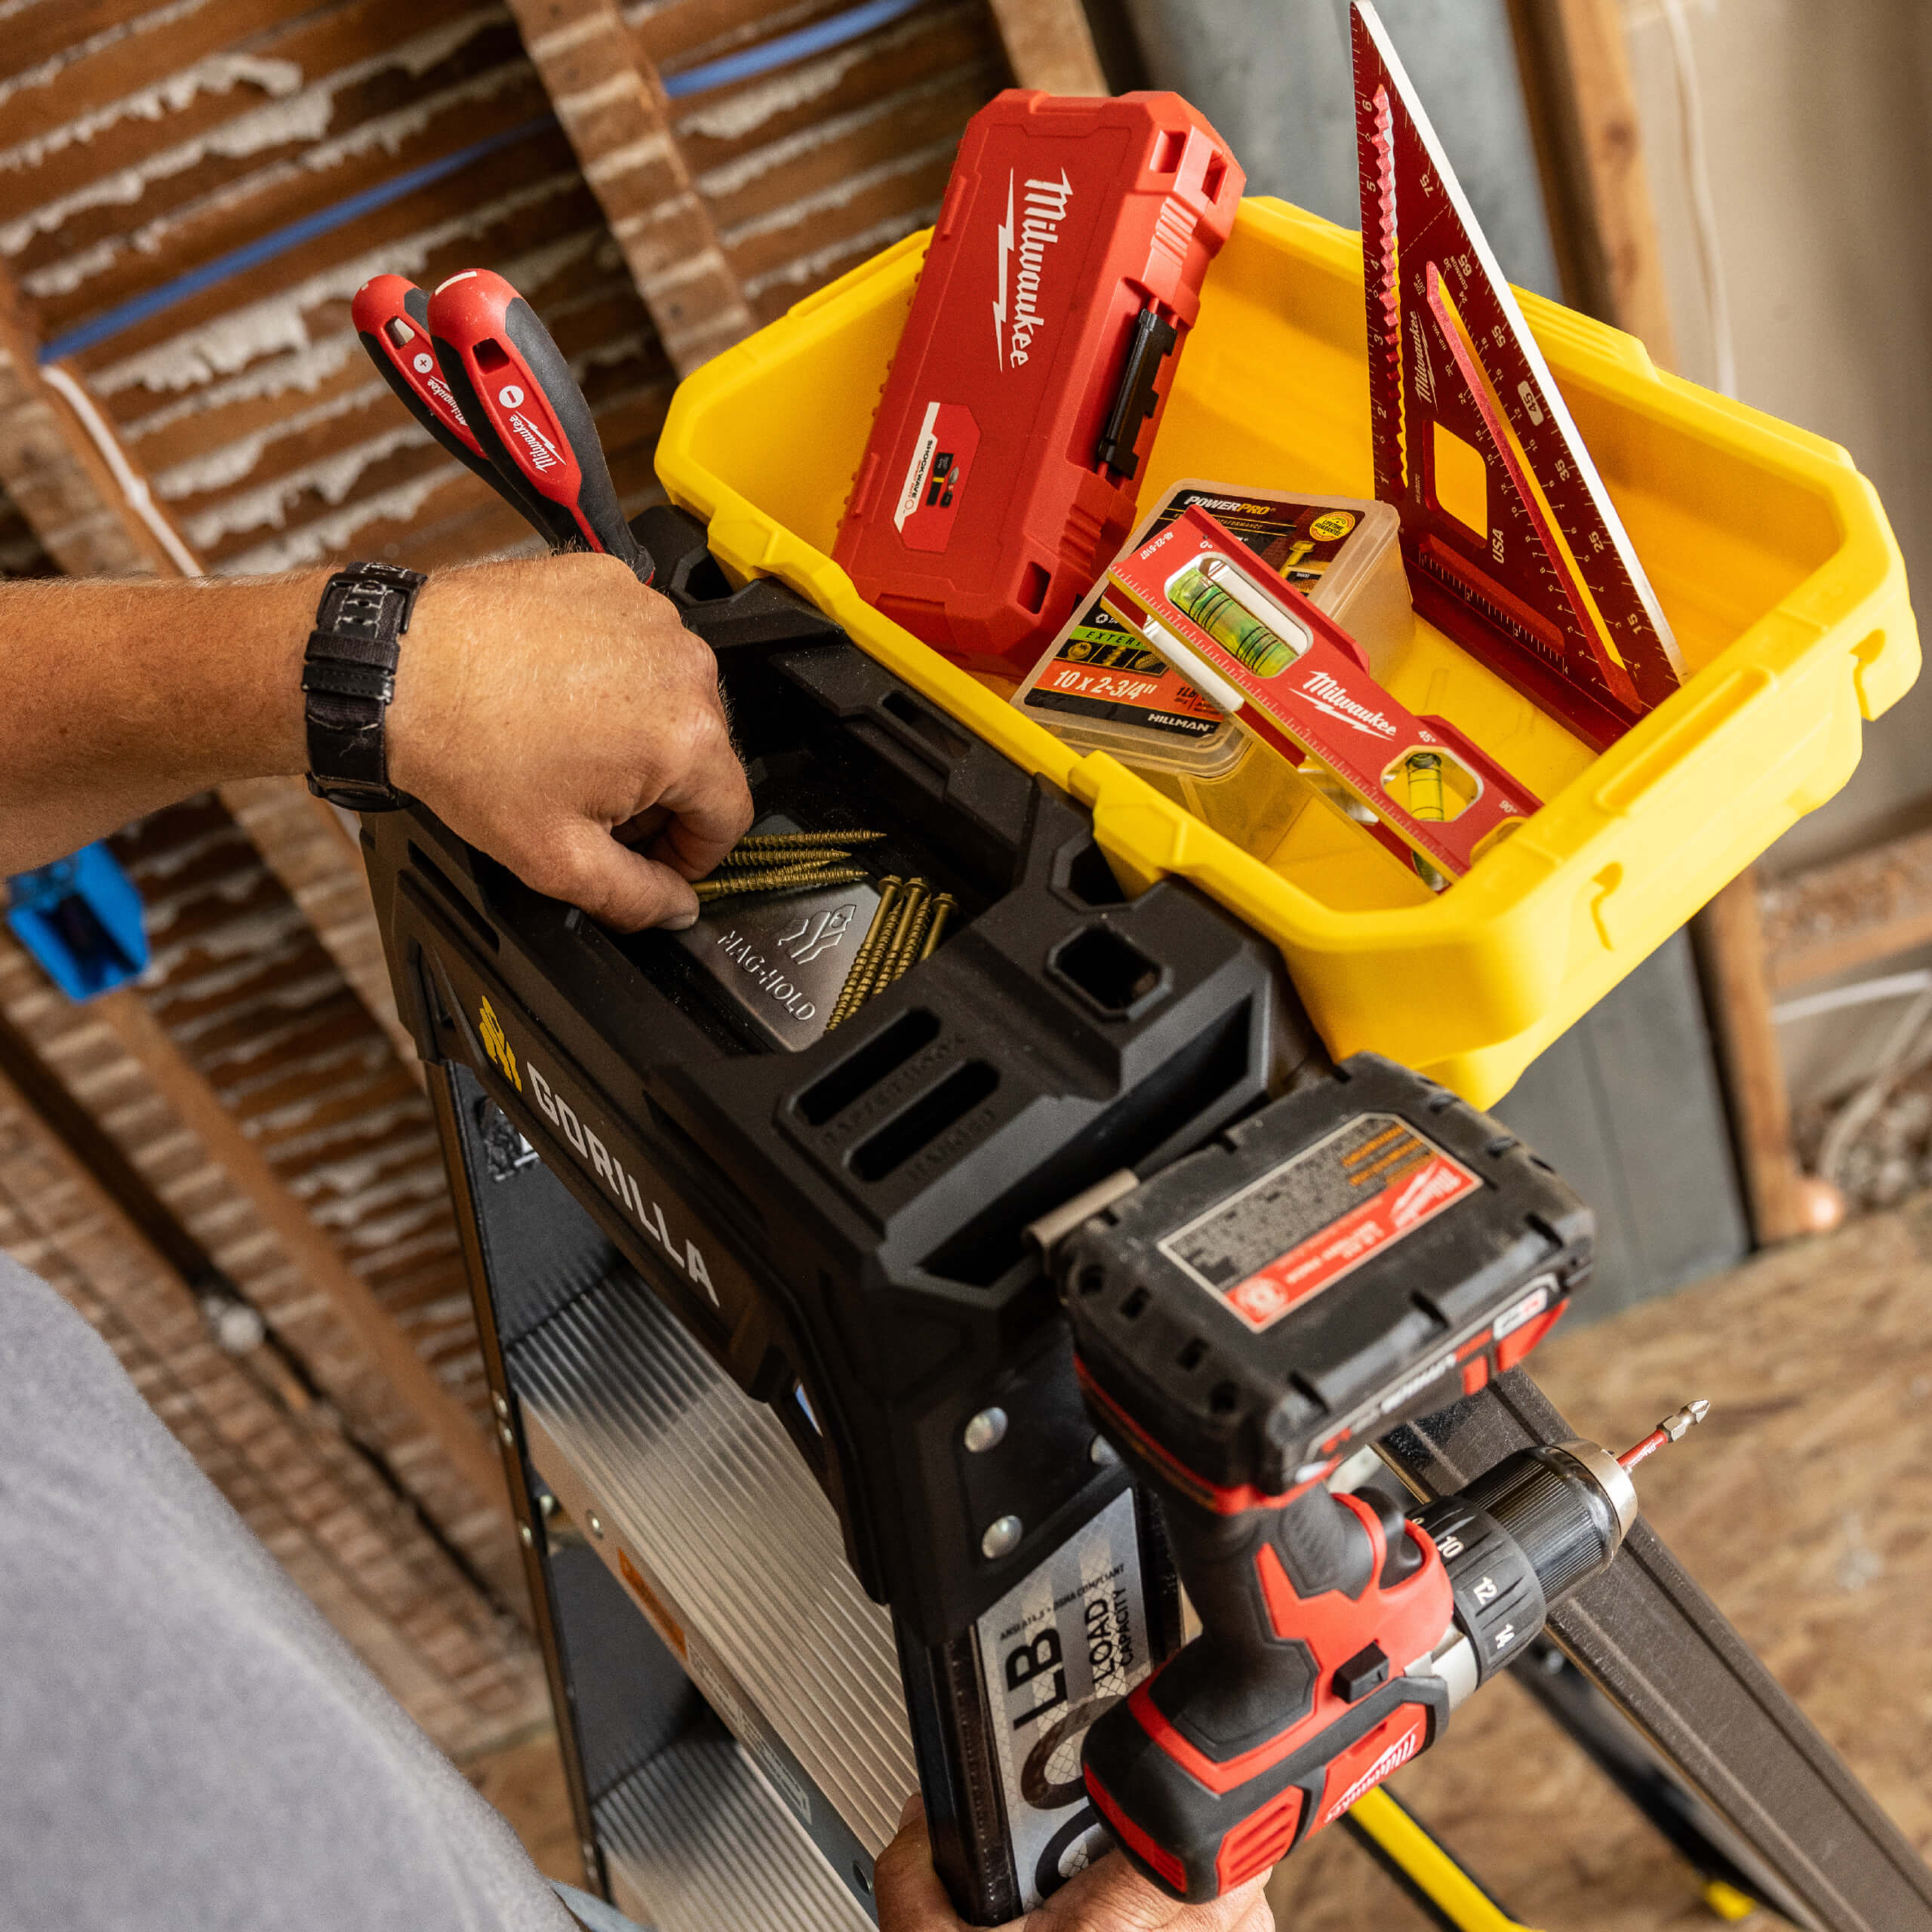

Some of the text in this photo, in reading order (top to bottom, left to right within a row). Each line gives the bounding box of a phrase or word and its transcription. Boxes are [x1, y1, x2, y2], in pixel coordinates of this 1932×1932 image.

[1362, 100, 1373, 112] 6
[1366, 180, 1377, 192] 5
[1420, 174, 1434, 198] 75
[1010, 166, 1074, 368] Milwaukee
[1370, 259, 1380, 270] 4
[1443, 257, 1452, 271] 30
[1450, 255, 1468, 291] COMMON
[1457, 254, 1472, 276] 65
[1459, 291, 1468, 303] 24
[1374, 334, 1383, 346] 3
[1481, 337, 1490, 349] 18
[1491, 325, 1506, 348] 55
[1409, 310, 1432, 404] Milwaukee
[1444, 365, 1454, 377] 30
[1496, 368, 1504, 380] 15
[1458, 392, 1467, 405] 24
[1523, 392, 1537, 412] 45
[1377, 406, 1386, 418] 2
[1514, 407, 1522, 420] 12
[509, 414, 557, 473] Milwaukee
[1475, 429, 1484, 441] 18
[1529, 439, 1538, 451] 10
[912, 440, 933, 498] SHOCKWAVE
[1487, 454, 1495, 466] 15
[1555, 459, 1571, 481] 35
[1380, 475, 1389, 485] 1
[1500, 483, 1509, 495] 12
[1184, 496, 1271, 515] POWERPRO
[1512, 506, 1520, 518] 10
[1140, 531, 1174, 560] 48-22-5107
[1492, 528, 1505, 564] USA
[1588, 531, 1605, 553] 25
[1626, 613, 1643, 635] 15
[1053, 669, 1081, 688] 10
[1091, 676, 1158, 700] 2-3/4"
[1303, 670, 1397, 736] Milwaukee
[1148, 713, 1211, 732] HILLMAN
[1418, 731, 1438, 743] 45°
[718, 930, 816, 1021] MAG-HOLD
[527, 1061, 720, 1308] GORILLA
[1437, 1536, 1464, 1558] 10
[1473, 1577, 1498, 1605] 12
[1112, 1587, 1135, 1668] CAPACITY
[1495, 1623, 1515, 1650] 14
[1084, 1598, 1115, 1684] LOAD
[1005, 1628, 1068, 1730] LB
